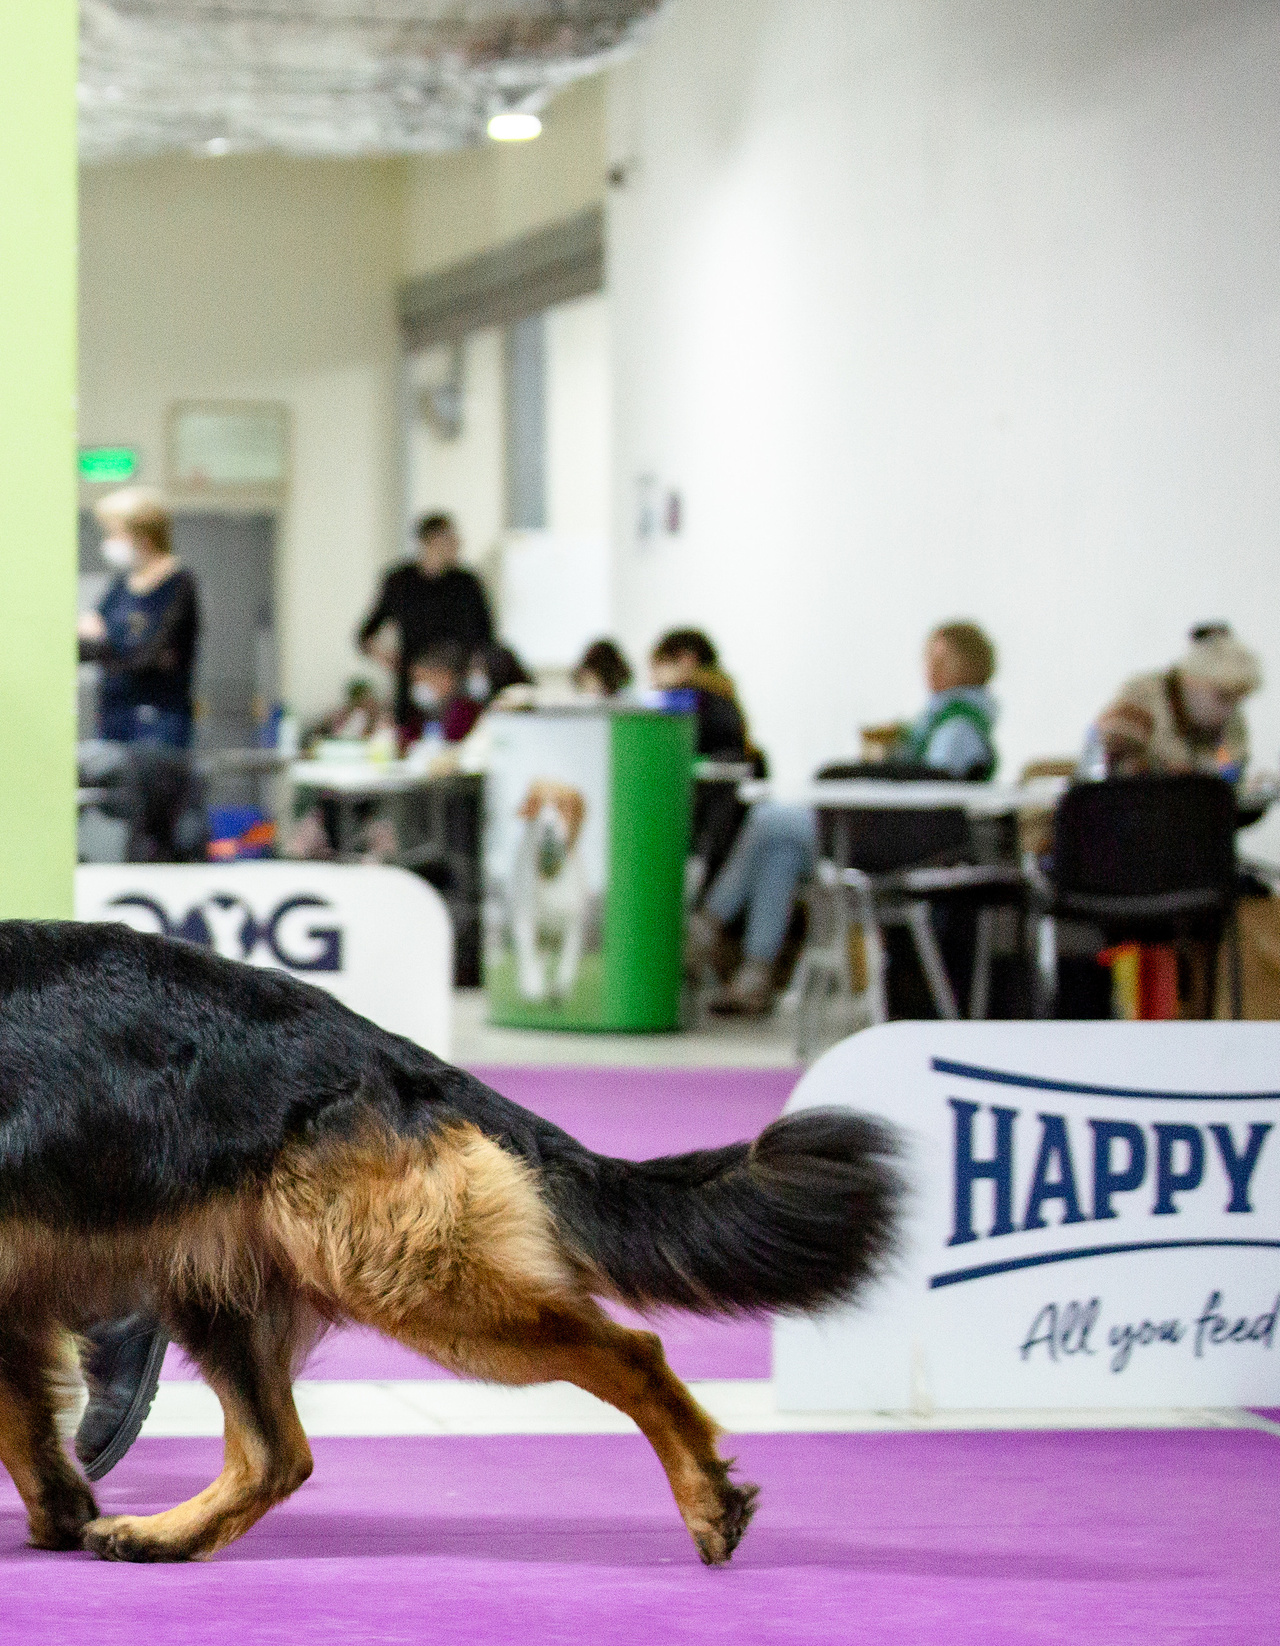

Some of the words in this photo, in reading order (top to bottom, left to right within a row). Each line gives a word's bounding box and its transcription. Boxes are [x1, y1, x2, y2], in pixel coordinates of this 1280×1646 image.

[947, 1098, 1273, 1247] HAPPY
[1019, 1296, 1101, 1361] All
[1107, 1318, 1187, 1374] you
[1193, 1289, 1280, 1359] feed
